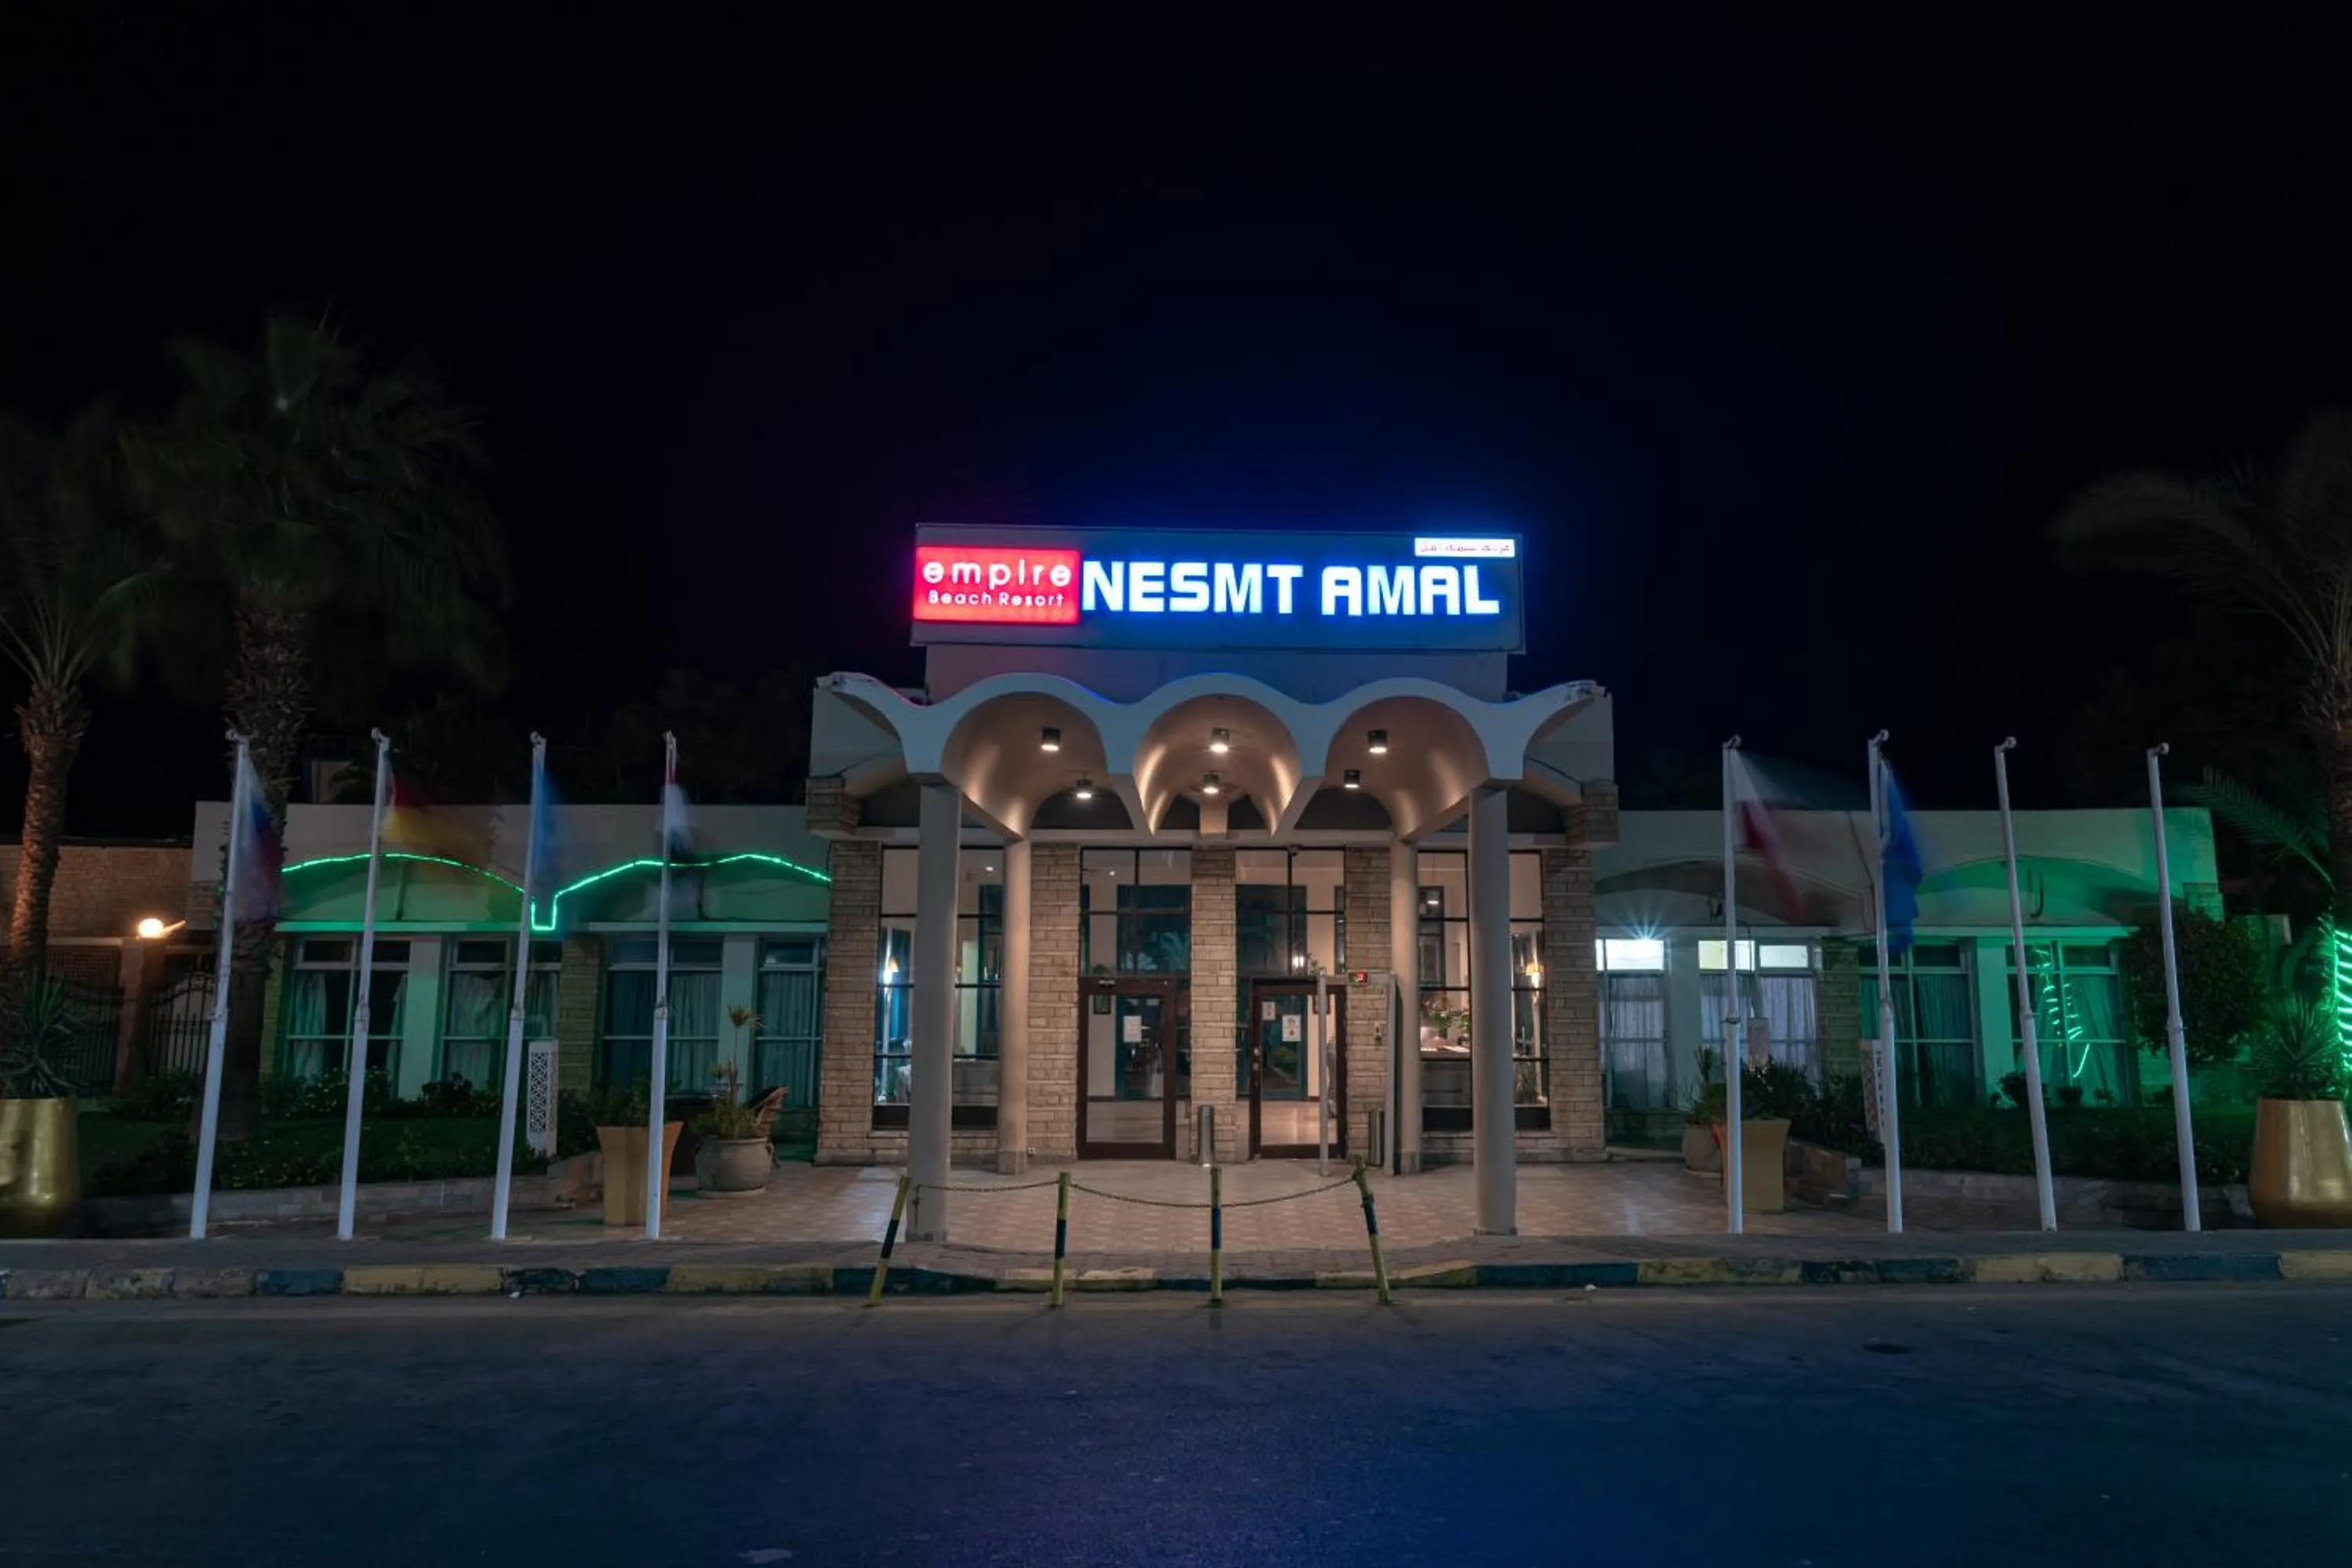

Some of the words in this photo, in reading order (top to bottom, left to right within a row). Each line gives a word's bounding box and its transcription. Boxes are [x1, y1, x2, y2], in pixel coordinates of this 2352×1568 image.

[923, 558, 1072, 590] empire
[1082, 561, 1303, 614] NESMT
[1322, 565, 1500, 615] AMAL
[928, 590, 993, 605] Beach
[999, 592, 1064, 607] Resort
